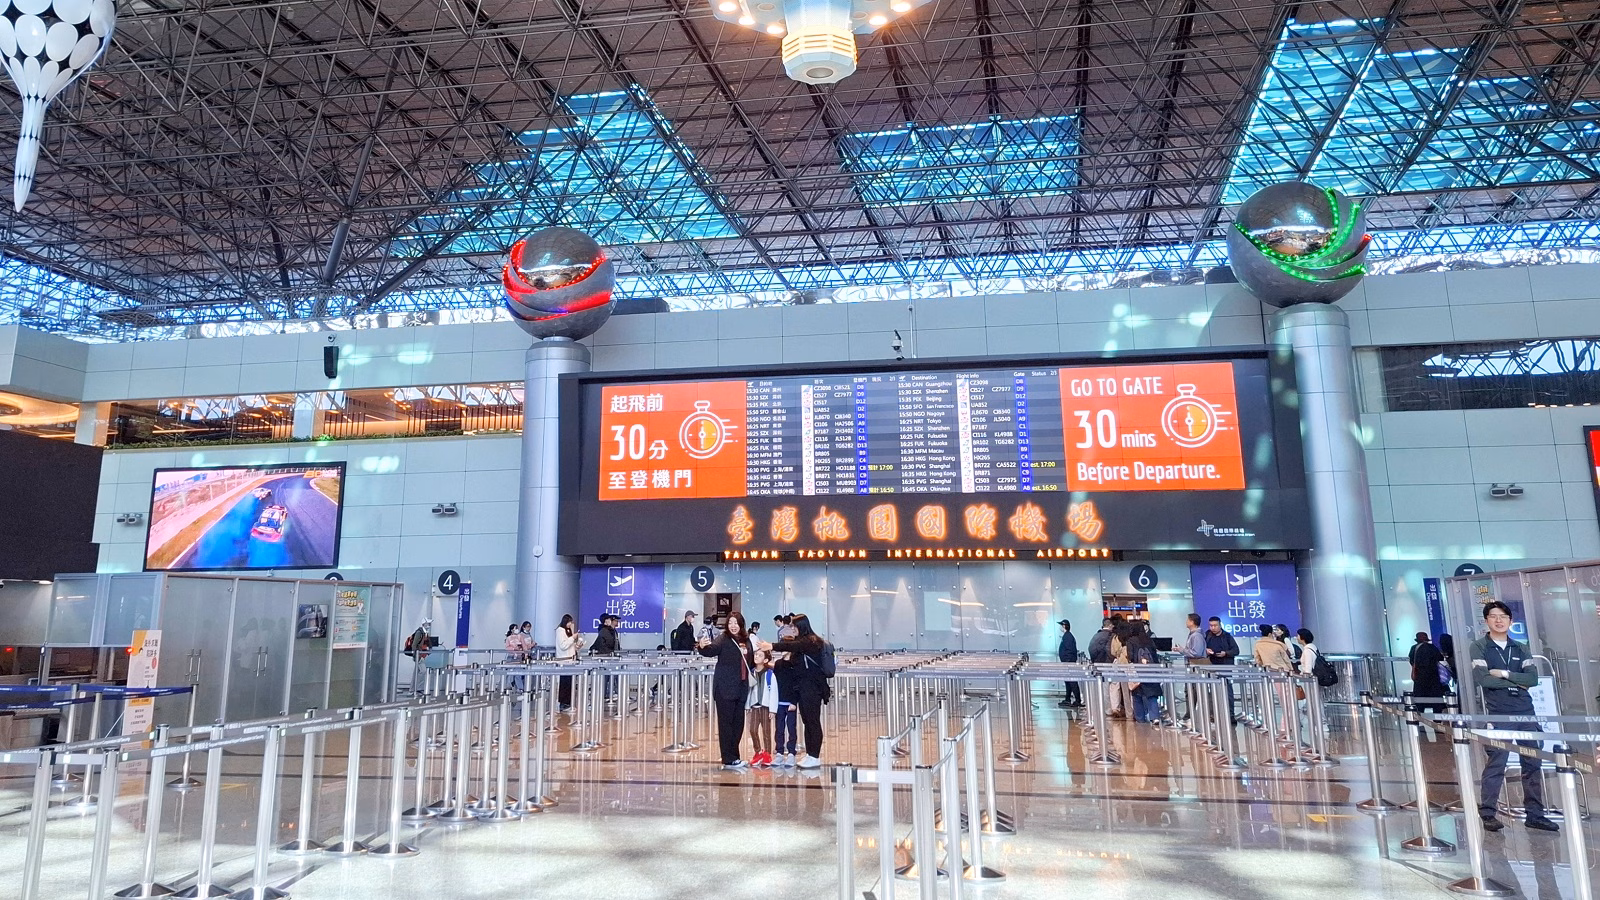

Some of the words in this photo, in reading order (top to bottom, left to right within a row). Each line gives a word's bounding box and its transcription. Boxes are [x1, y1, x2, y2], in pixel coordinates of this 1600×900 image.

[1071, 379, 1092, 396] GO
[1097, 378, 1116, 396] TO
[1122, 377, 1163, 395] GATE
[610, 393, 663, 413] 起飛前
[1074, 409, 1116, 448] 30
[1122, 430, 1156, 448] mins
[608, 470, 692, 489] 至登機門
[1078, 462, 1130, 484] Before
[1134, 462, 1220, 483] Departure.
[727, 502, 1103, 543] 臺灣桃園國際機場
[724, 550, 779, 559] TAIWAN
[798, 550, 866, 558] TAOYUAN
[887, 549, 1016, 558] INTERNATIONAL
[1036, 549, 1109, 558] AIRPORT
[443, 575, 453, 590] 4
[698, 571, 707, 586] 5
[1138, 570, 1150, 587] 6
[606, 600, 636, 616] 出發
[1228, 600, 1266, 618] 出發
